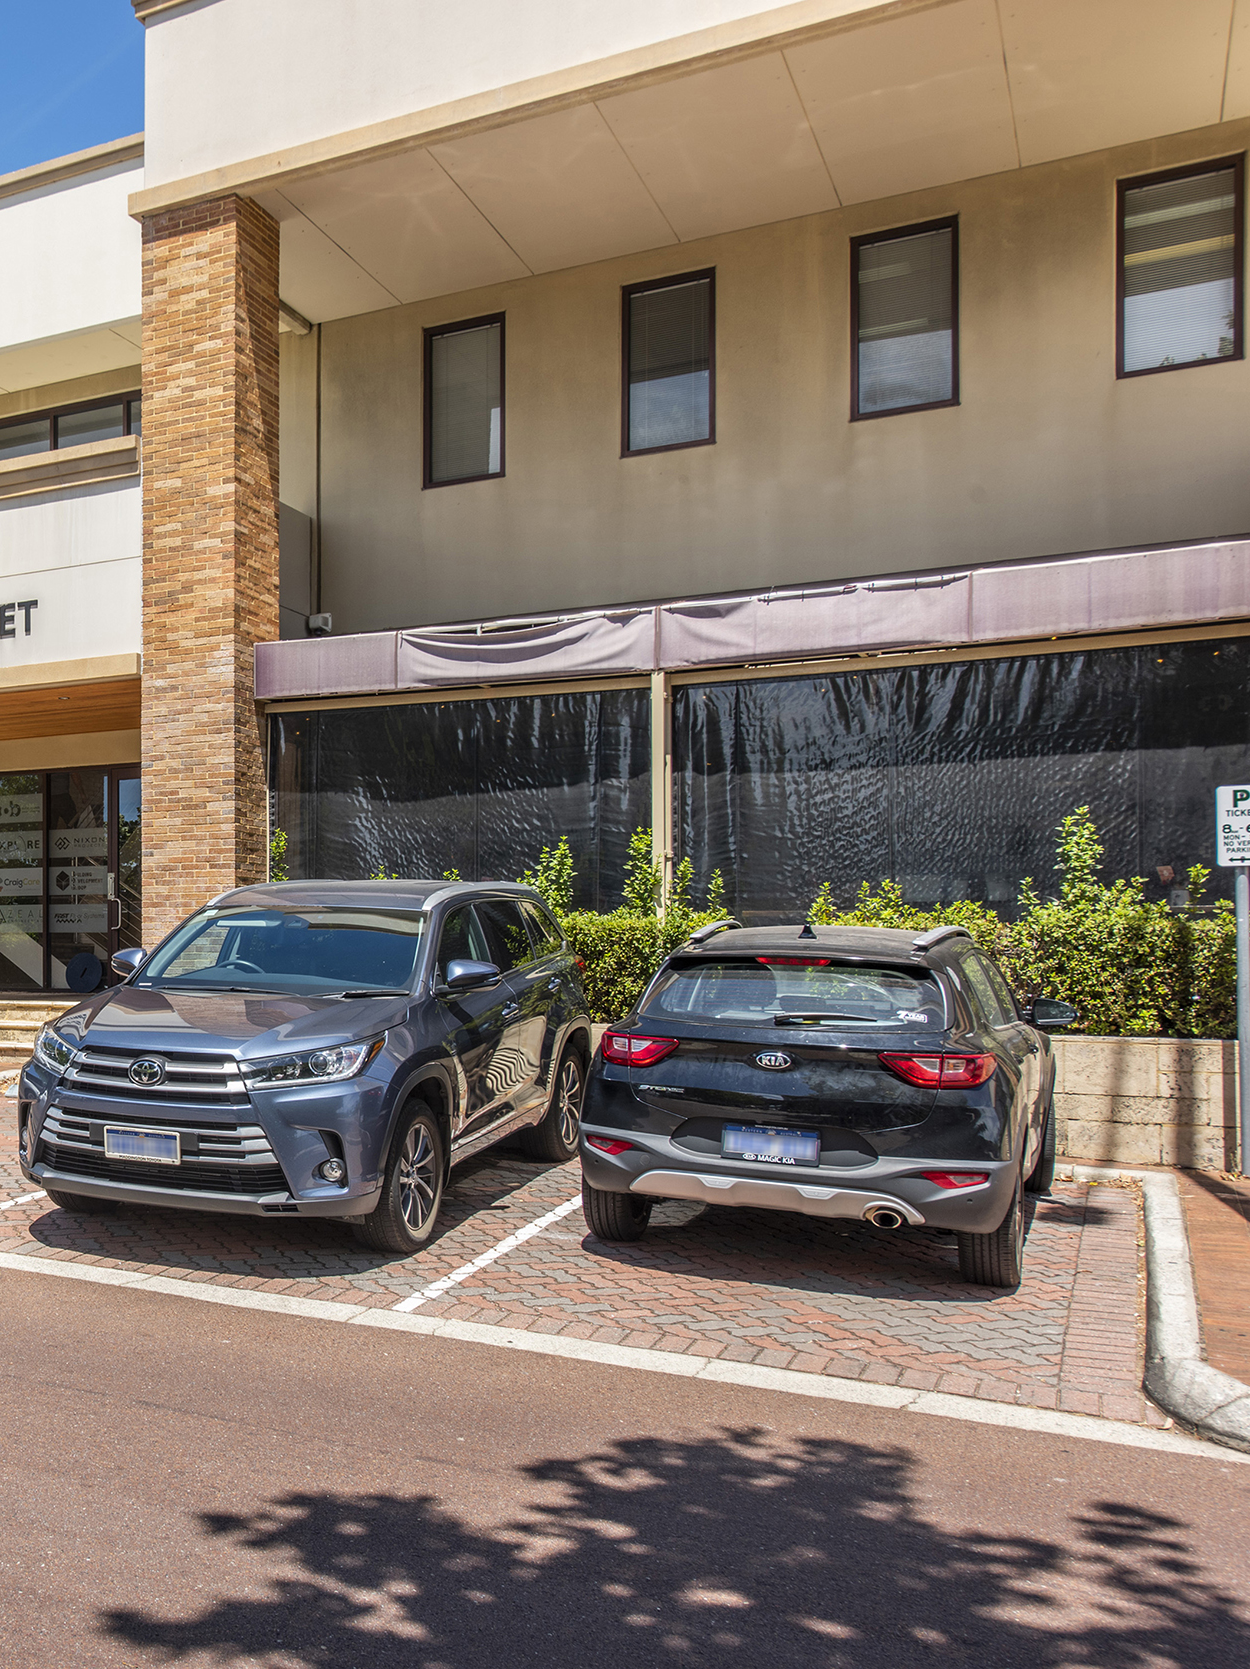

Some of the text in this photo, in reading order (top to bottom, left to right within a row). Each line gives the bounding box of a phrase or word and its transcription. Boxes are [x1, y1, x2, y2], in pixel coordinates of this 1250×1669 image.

[74, 836, 105, 844] NIXON
[7, 909, 43, 919] ZEAL
[761, 1055, 786, 1067] KIA
[757, 1154, 782, 1164] MAGIC
[782, 1157, 796, 1165] KIA
